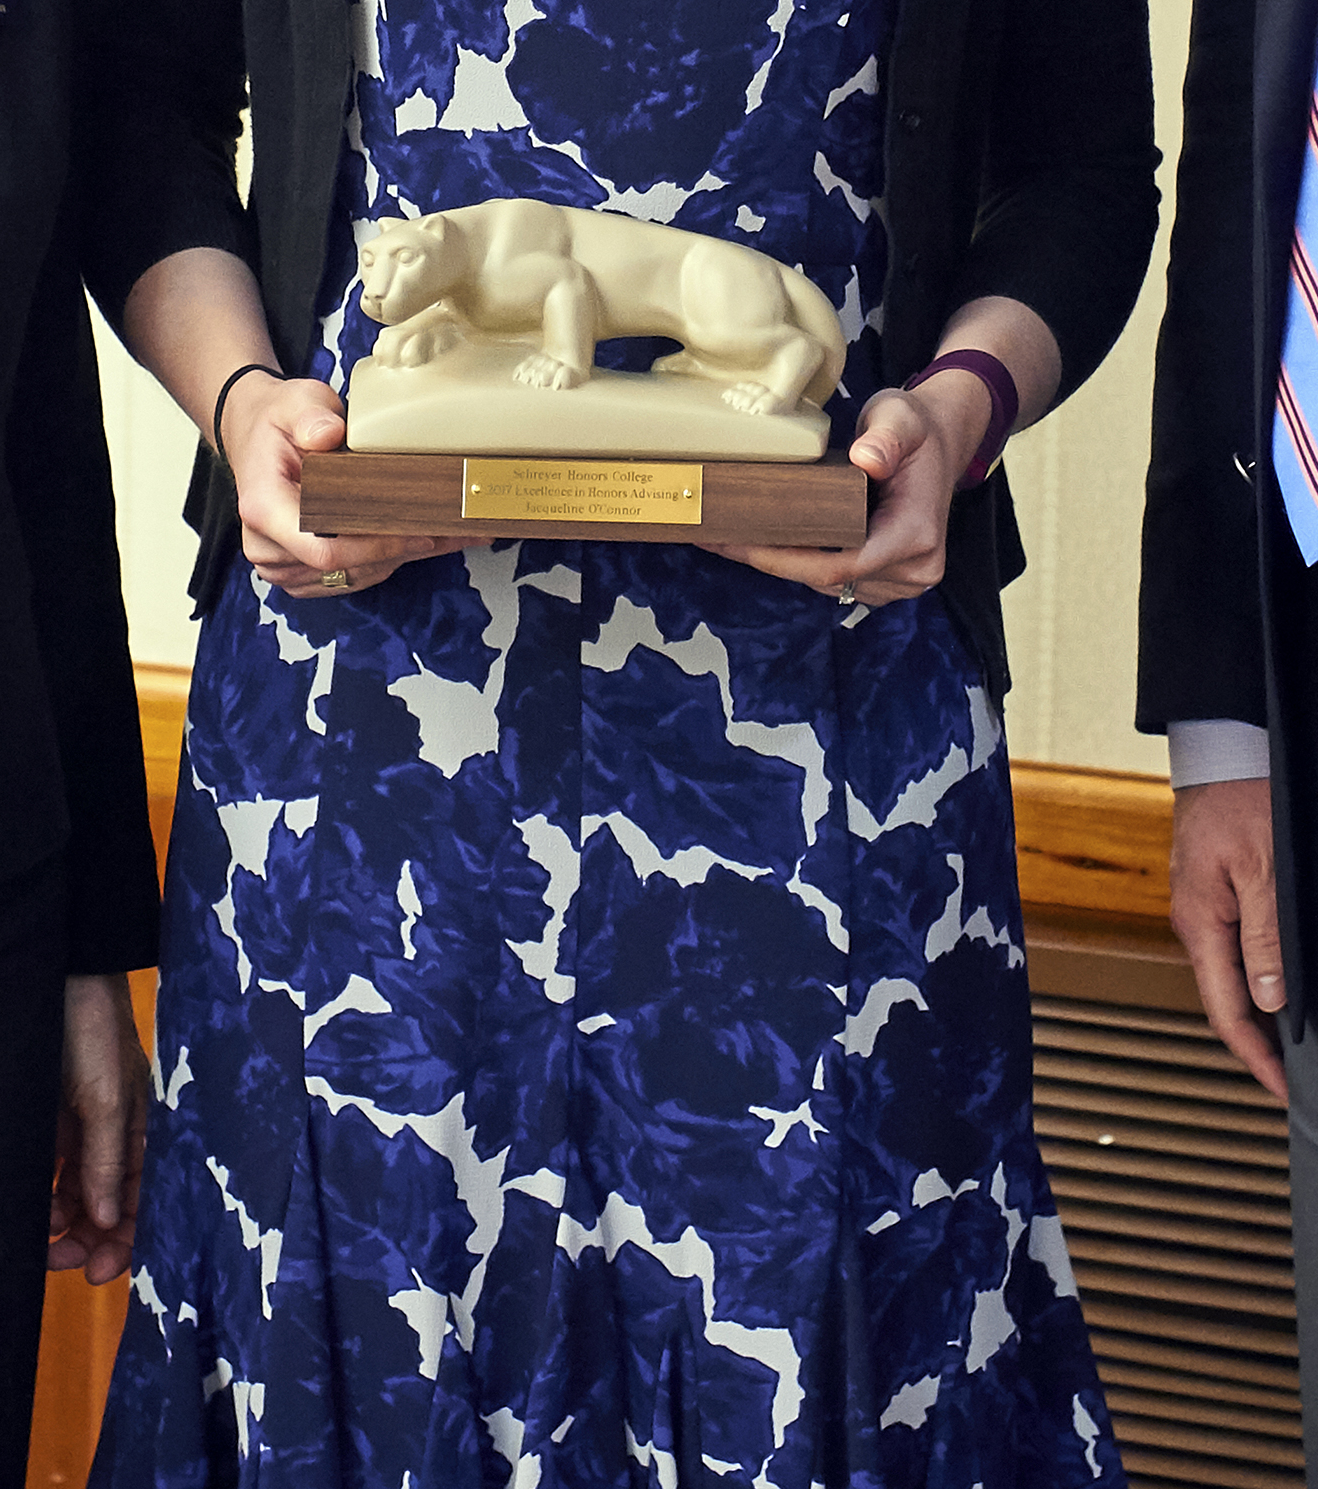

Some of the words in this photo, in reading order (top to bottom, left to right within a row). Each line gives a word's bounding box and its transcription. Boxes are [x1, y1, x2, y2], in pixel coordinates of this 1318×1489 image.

[513, 469, 561, 482] Schreyer
[568, 470, 608, 481] Honors
[612, 471, 653, 484] College
[515, 485, 572, 497] Excellence
[575, 486, 585, 497] in
[588, 487, 627, 498] Honors
[631, 488, 679, 501] Advising
[526, 502, 584, 515] Jacqueline
[589, 503, 641, 515] O'Connor
